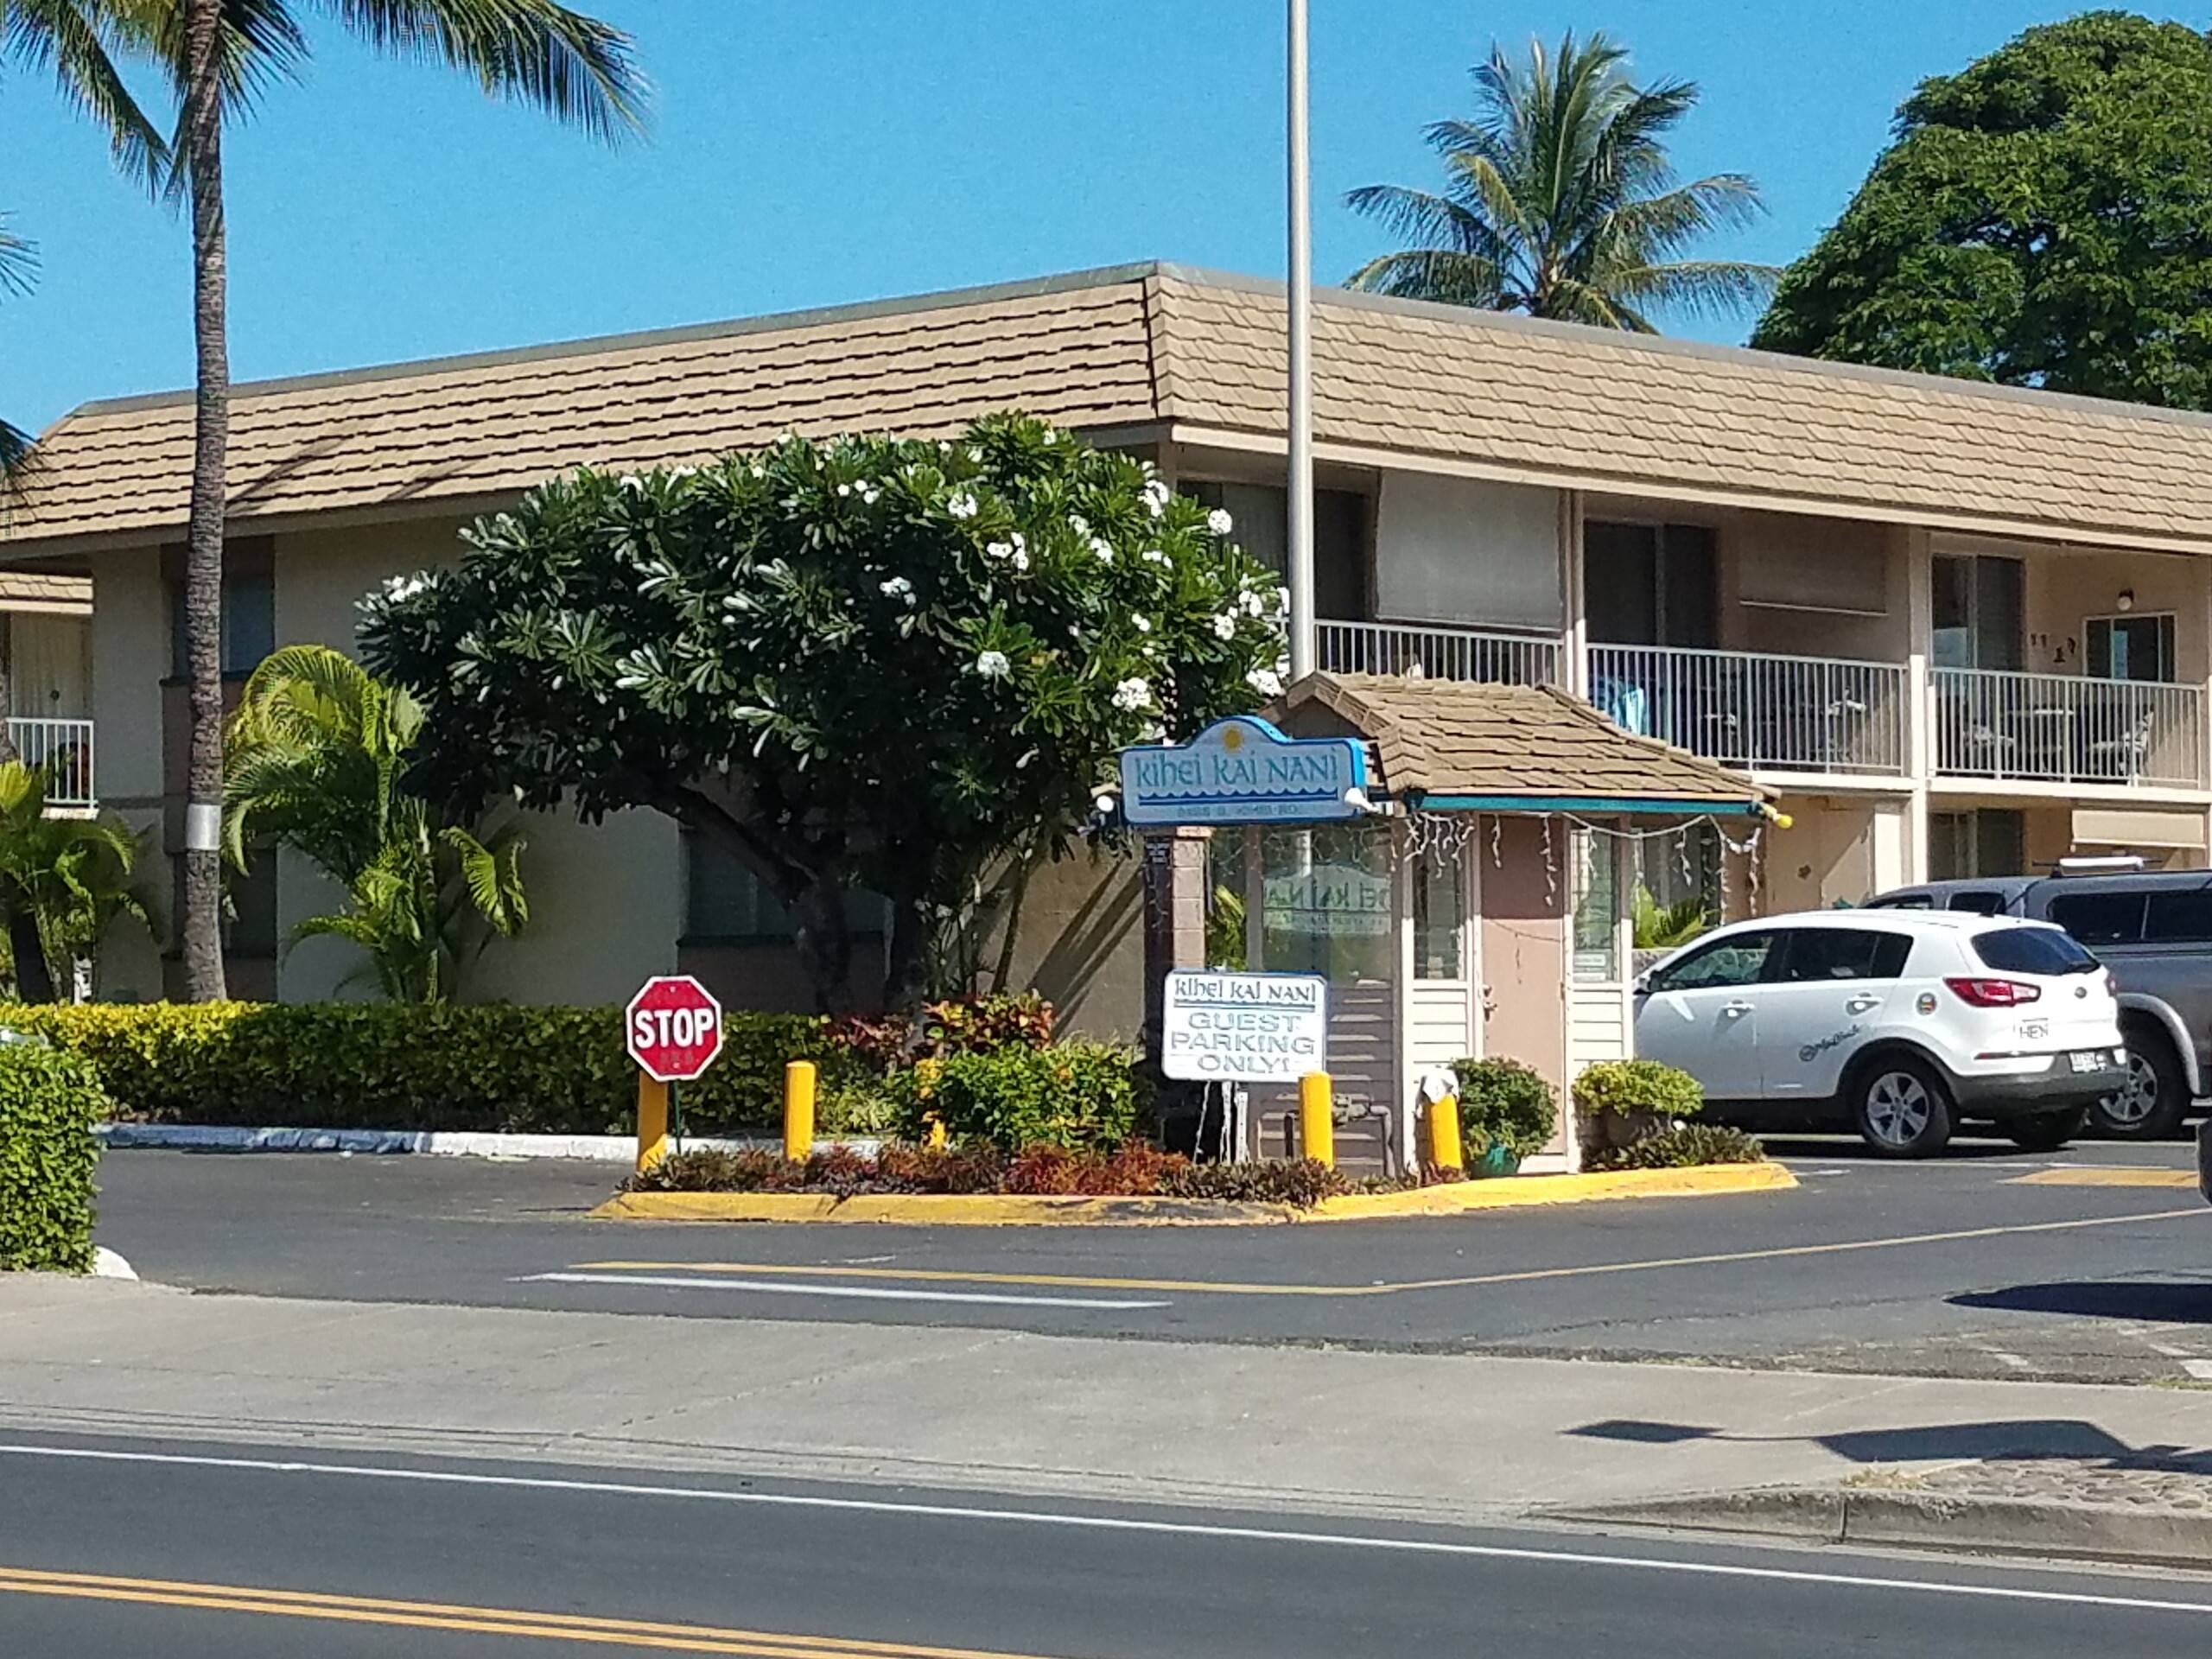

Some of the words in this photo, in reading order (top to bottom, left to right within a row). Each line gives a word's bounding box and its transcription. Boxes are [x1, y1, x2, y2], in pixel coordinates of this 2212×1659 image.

[634, 1007, 715, 1049] STOP
[1188, 1011, 1302, 1033] GUEST
[1171, 1031, 1316, 1055] PARKING
